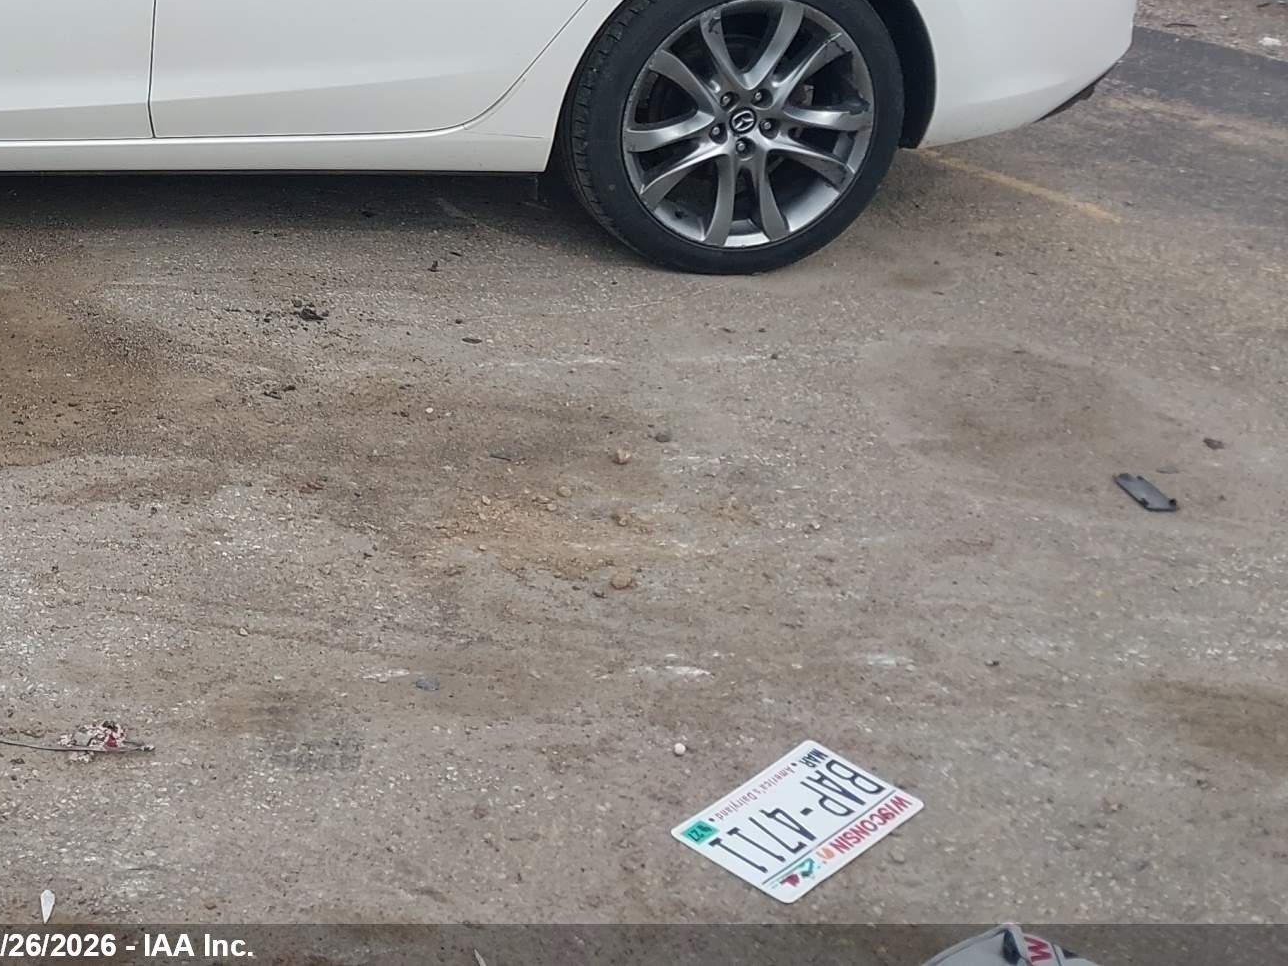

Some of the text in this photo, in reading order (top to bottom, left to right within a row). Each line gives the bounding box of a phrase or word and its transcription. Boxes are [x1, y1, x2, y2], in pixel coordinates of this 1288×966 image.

[798, 747, 829, 768] MAR
[709, 759, 884, 873] BAP-4711
[831, 794, 912, 854] WISCONSIN
